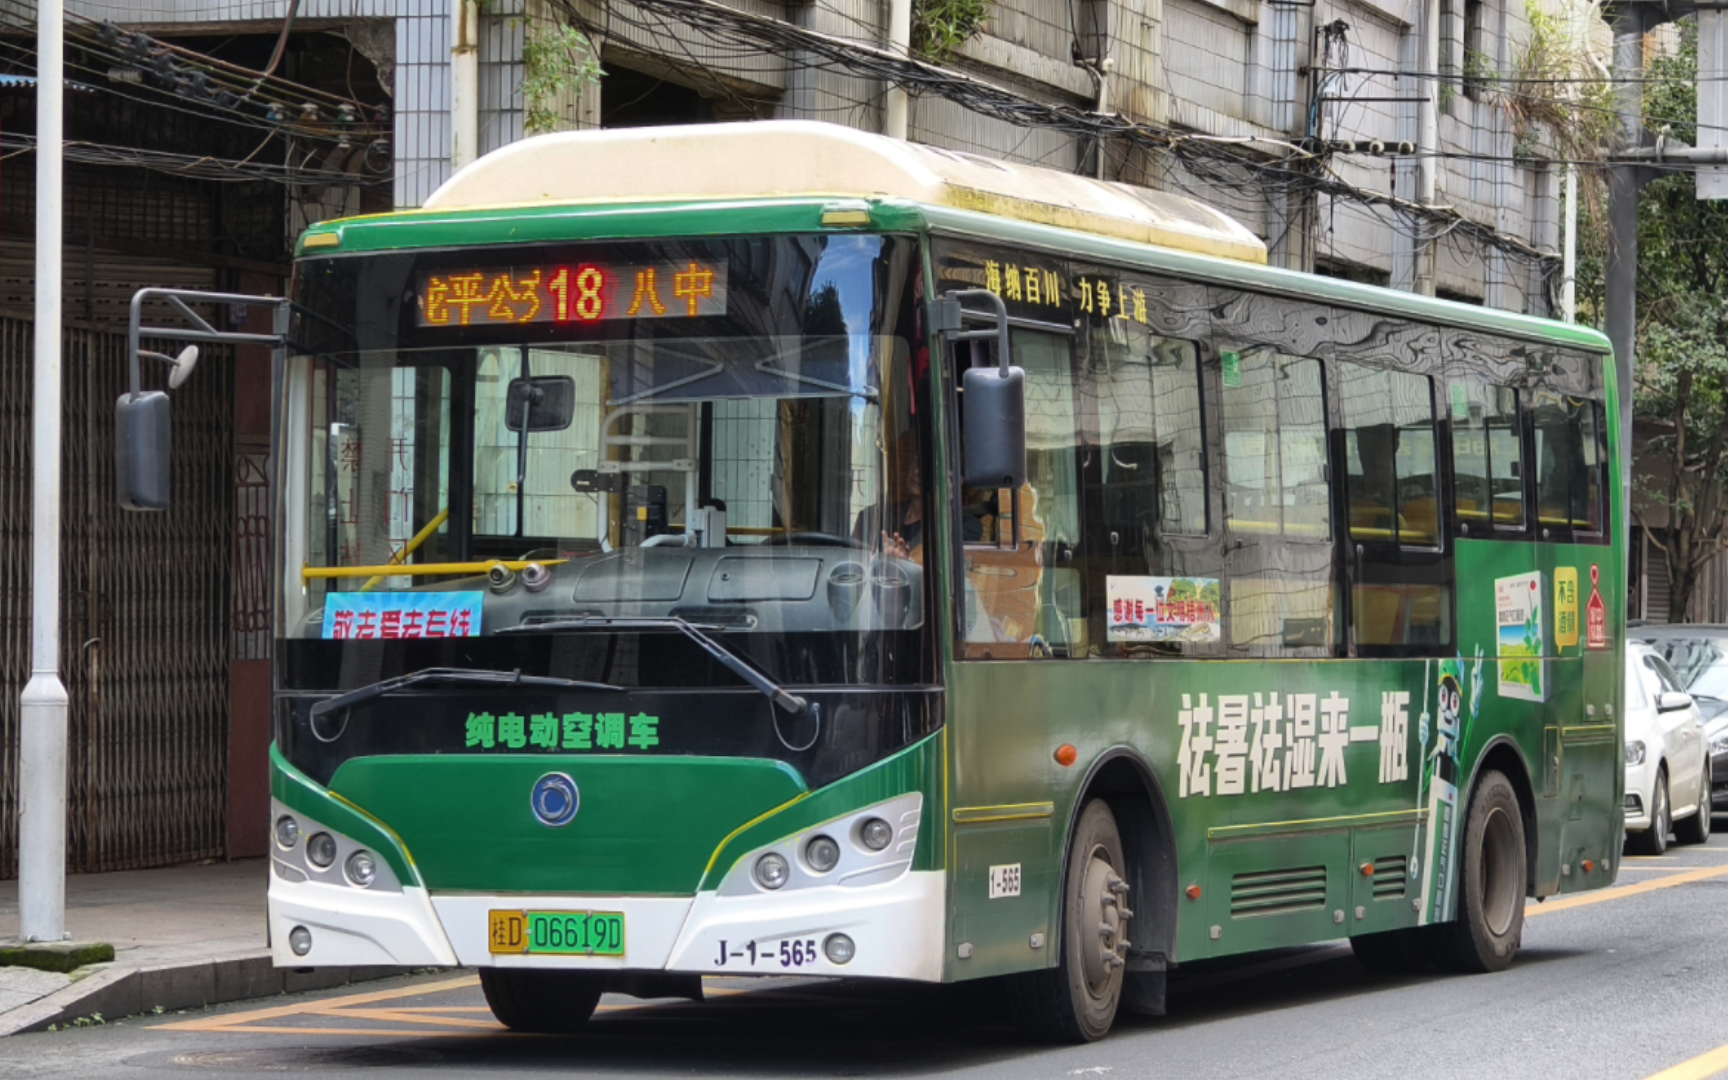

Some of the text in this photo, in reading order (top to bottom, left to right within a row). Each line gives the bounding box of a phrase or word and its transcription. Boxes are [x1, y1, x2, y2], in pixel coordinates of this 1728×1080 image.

[549, 267, 603, 321] 18
[627, 262, 714, 317] 八中
[985, 259, 1148, 325] 海纳百川 力争上游
[465, 711, 660, 750] 纯电动空调车
[1177, 691, 1410, 799] 祛暑祛湿来一瓶
[991, 866, 1020, 896] 1-565
[492, 916, 621, 949] 桂D 06619D
[714, 939, 818, 967] J-1-565
